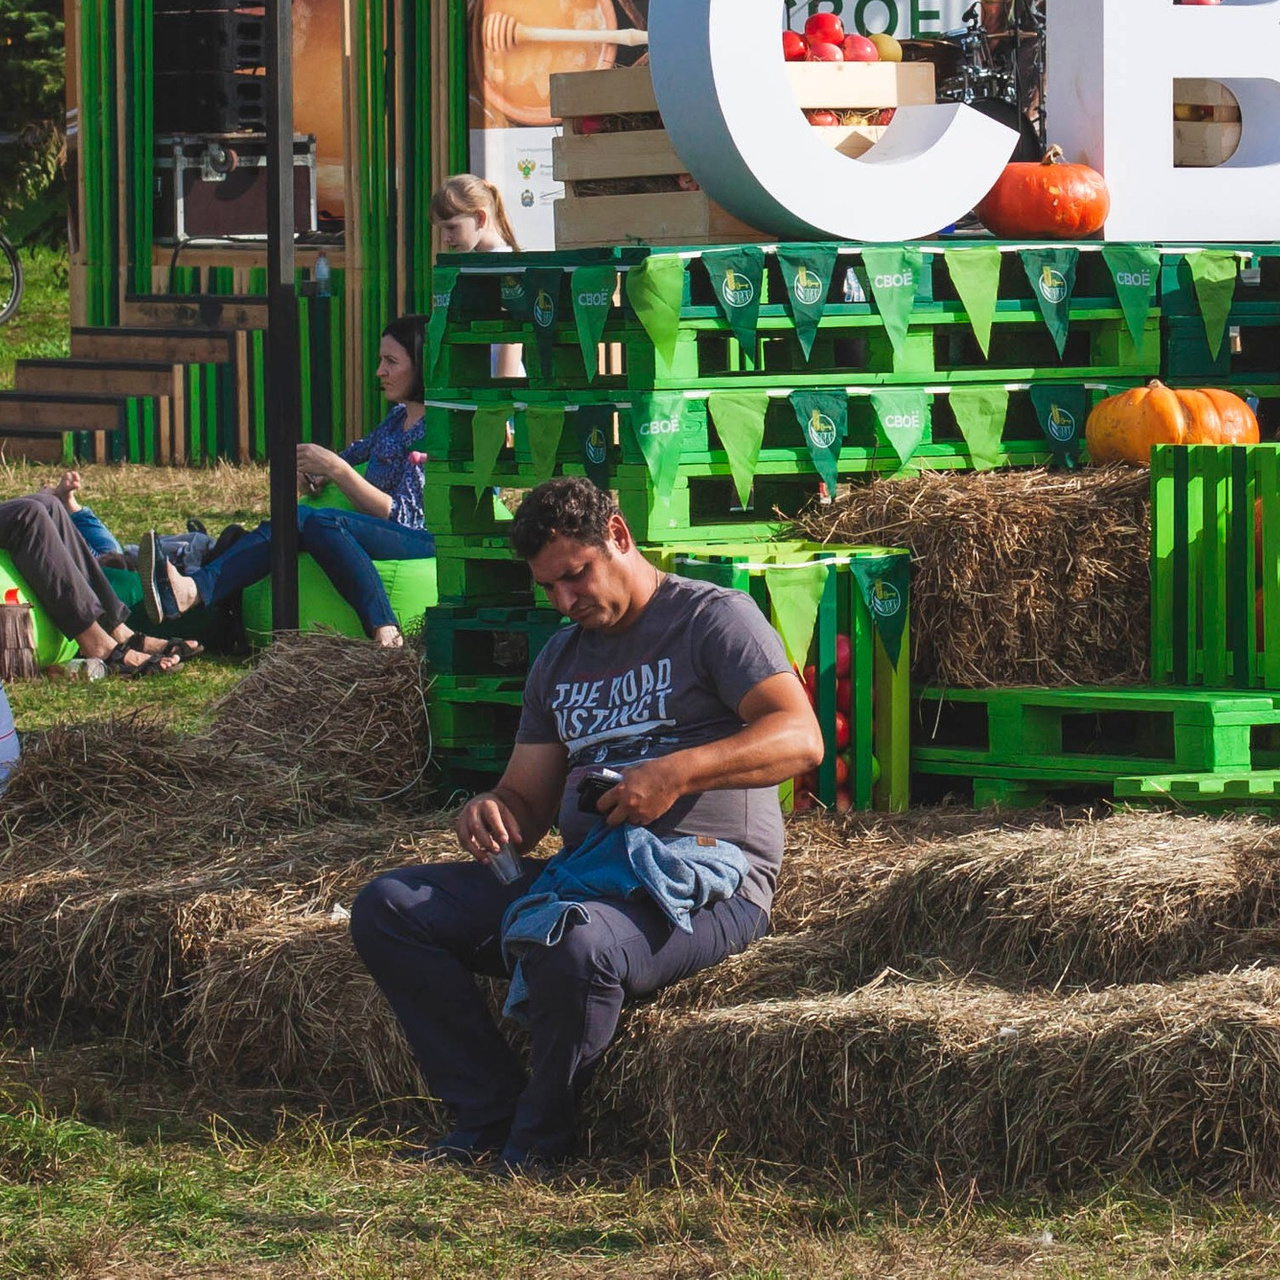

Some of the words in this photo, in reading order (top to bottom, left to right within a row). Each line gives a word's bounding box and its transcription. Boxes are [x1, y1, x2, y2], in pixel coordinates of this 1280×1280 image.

[874, 268, 913, 289] СВОЁ
[1116, 269, 1151, 286] СВОЁ
[578, 288, 609, 306] СВОЁ
[640, 414, 680, 436] СВОЁ
[885, 410, 920, 428] СВОЁ
[552, 680, 604, 709] THE
[608, 658, 671, 708] ROAD
